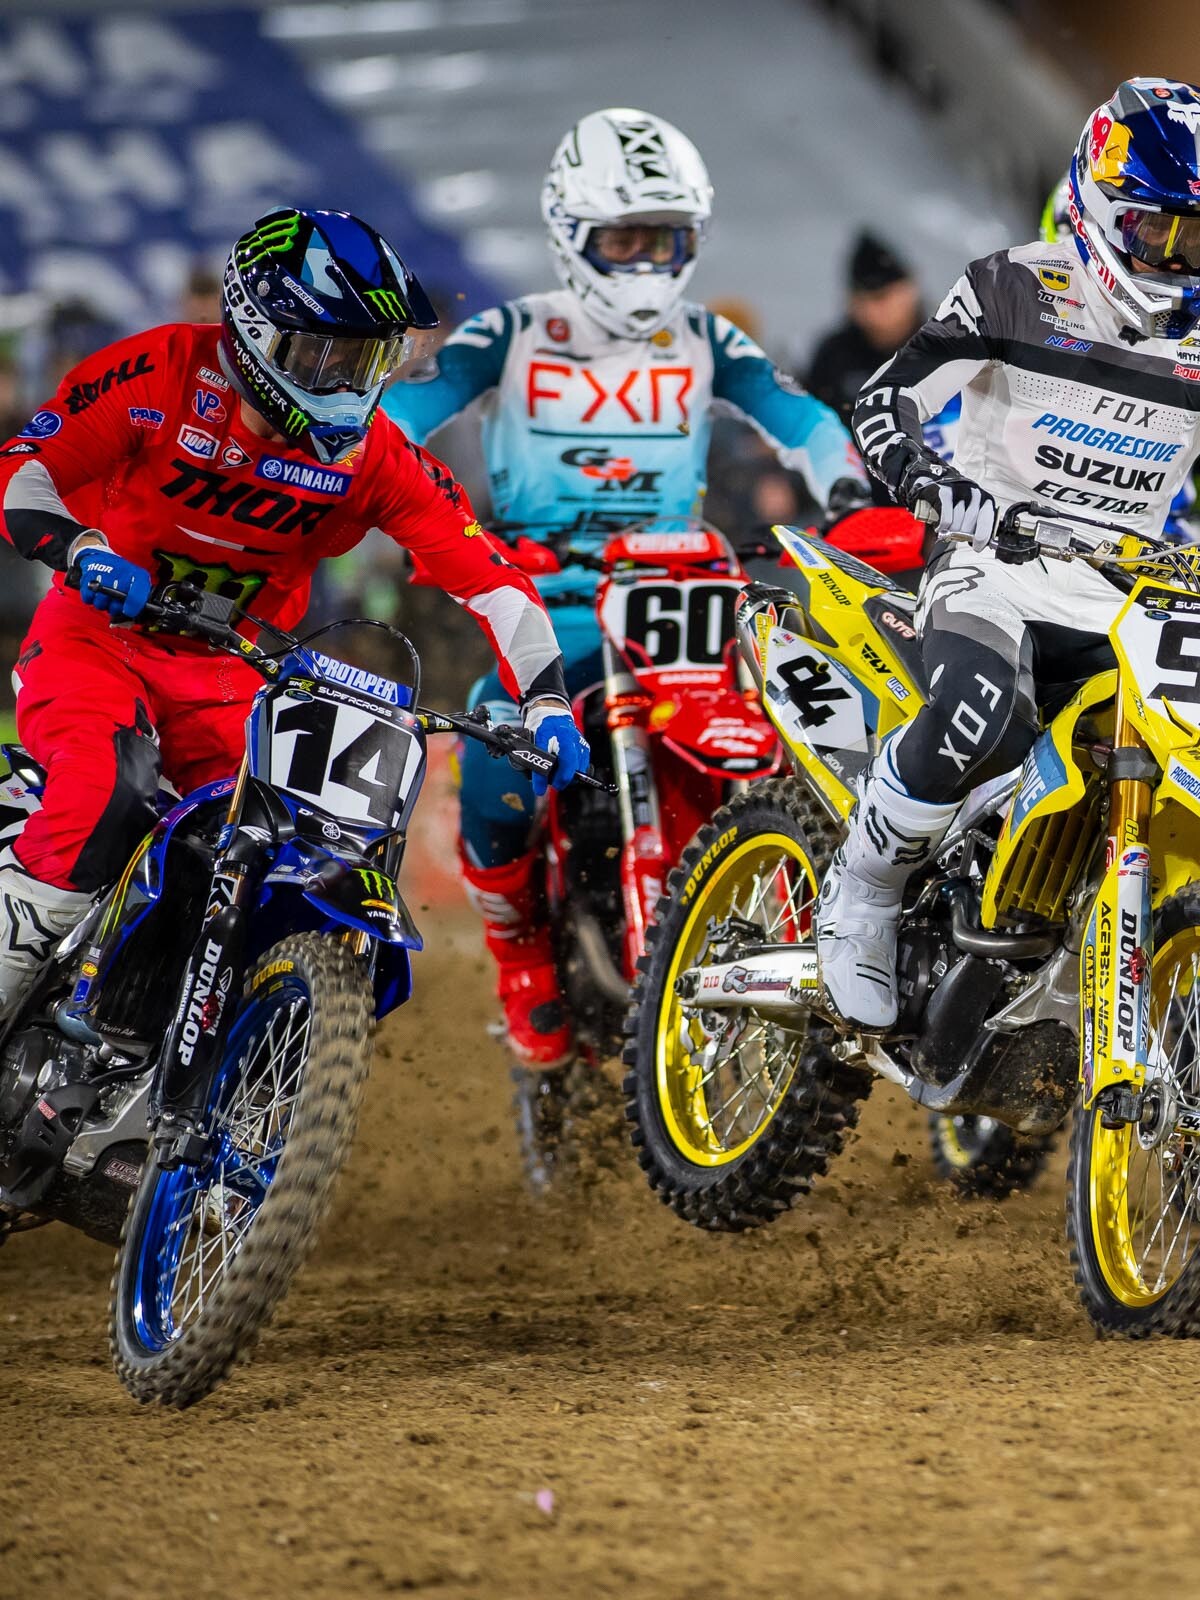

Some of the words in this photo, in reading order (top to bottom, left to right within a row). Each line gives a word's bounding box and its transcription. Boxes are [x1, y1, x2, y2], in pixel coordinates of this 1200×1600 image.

[281, 276, 325, 315] apdesigns
[1041, 312, 1086, 331] BREITLING
[199, 368, 230, 389] OPTIMA
[526, 361, 693, 423] FXR
[1092, 395, 1158, 428] FOX
[183, 431, 215, 455] 100%
[1031, 412, 1185, 463] PROGRESSIVE
[282, 464, 344, 493] YAMAHA
[1034, 443, 1166, 492] SUZUKI
[160, 457, 336, 536] THOR
[1032, 479, 1149, 515] ECSTAR
[87, 563, 114, 574] THOR
[818, 571, 852, 606] DUNLOP
[626, 585, 741, 668] 60
[882, 611, 917, 640] GUTS
[314, 651, 397, 703] PROTAPER
[861, 643, 893, 674] FLY
[318, 686, 392, 718] SUPERCROSS
[777, 655, 853, 728] 94
[937, 672, 1003, 772] FOX
[274, 702, 413, 828] 14
[512, 750, 553, 770] ARC
[685, 826, 739, 900] DUNLOP
[1099, 900, 1112, 990] ACERBIS
[1117, 908, 1137, 1053] DUNLOP
[178, 937, 223, 1067] DUNLOP
[100, 1022, 120, 1035] Twin
[121, 1027, 137, 1037] Air
[1180, 1115, 1200, 1132] 94
